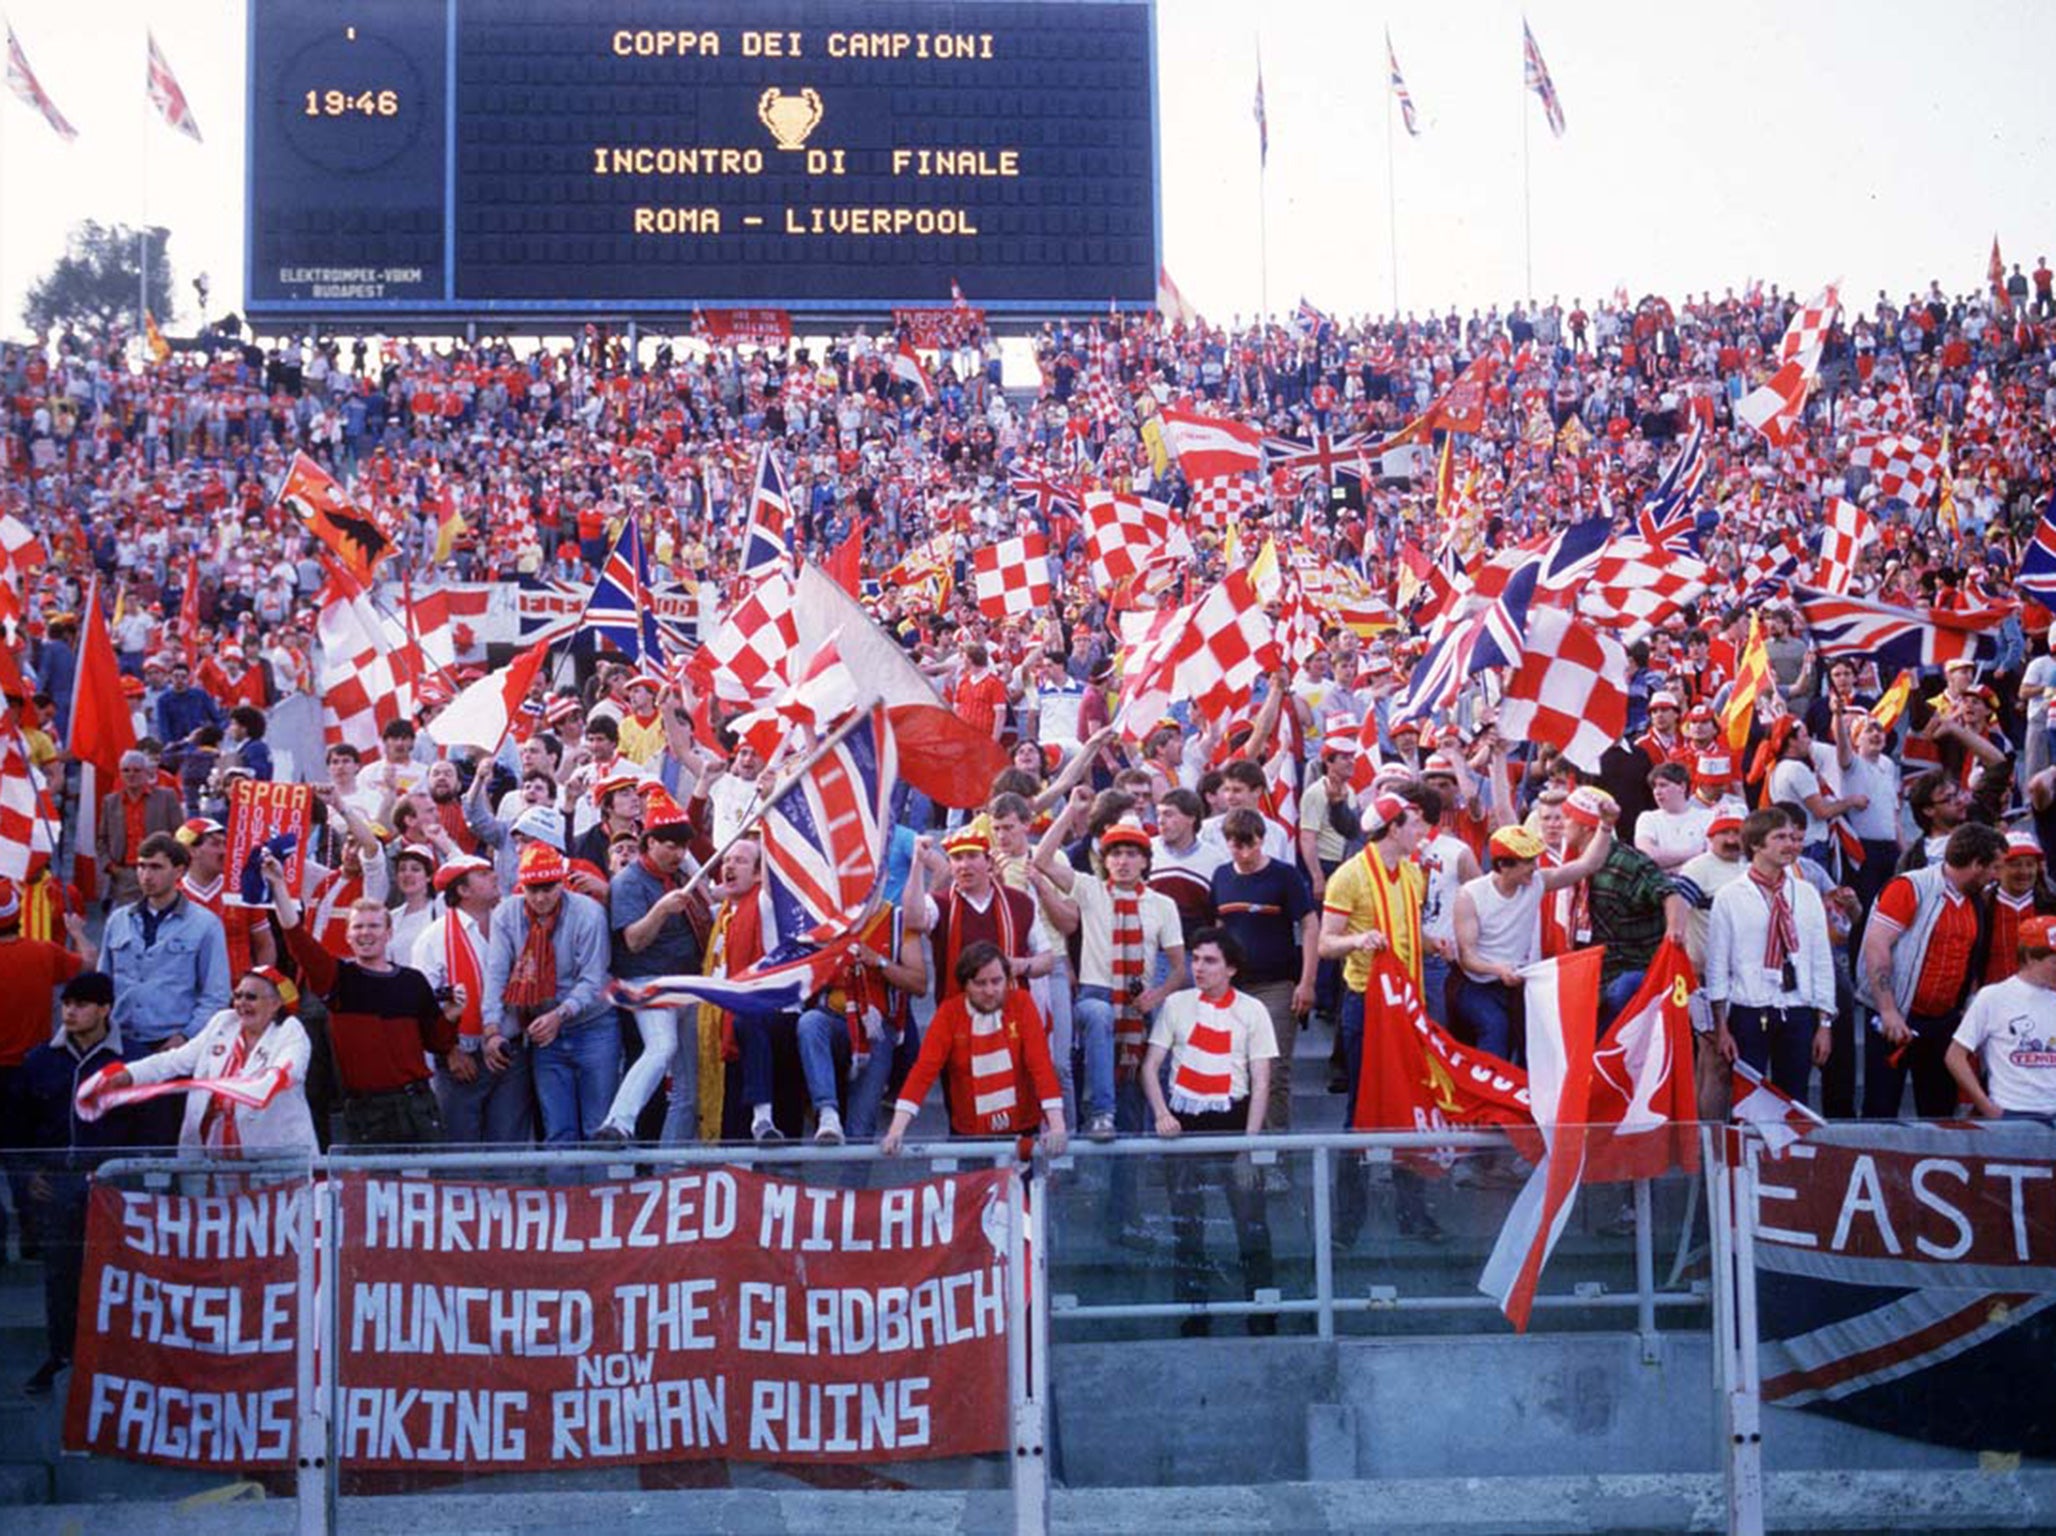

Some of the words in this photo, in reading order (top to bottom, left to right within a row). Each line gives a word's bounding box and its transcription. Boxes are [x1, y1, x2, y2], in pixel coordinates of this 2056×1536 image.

[613, 30, 720, 57] COPPA
[742, 31, 802, 57] DEI
[827, 32, 994, 59] CAMPIONI
[304, 90, 398, 116] 19:46
[594, 147, 763, 174] INCONTRO
[807, 150, 845, 174] DI
[893, 149, 1019, 176] FINALE
[634, 208, 720, 233] ROMA
[786, 208, 978, 234] LIVERPOOL
[312, 284, 384, 298] BUDAPEST
[365, 1170, 737, 1253] MARMALIZED
[758, 1179, 956, 1252] MILAN
[1749, 1137, 2054, 1262] EAST
[97, 1265, 298, 1355] PAISLE
[350, 1282, 594, 1358] MUNCHED
[614, 1278, 717, 1353] THE
[738, 1265, 1005, 1357] GLADBACH
[576, 1352, 655, 1388] NOW
[86, 1373, 296, 1461] FAGANS
[551, 1375, 728, 1461] ROMAN
[748, 1377, 931, 1453] RUINS
